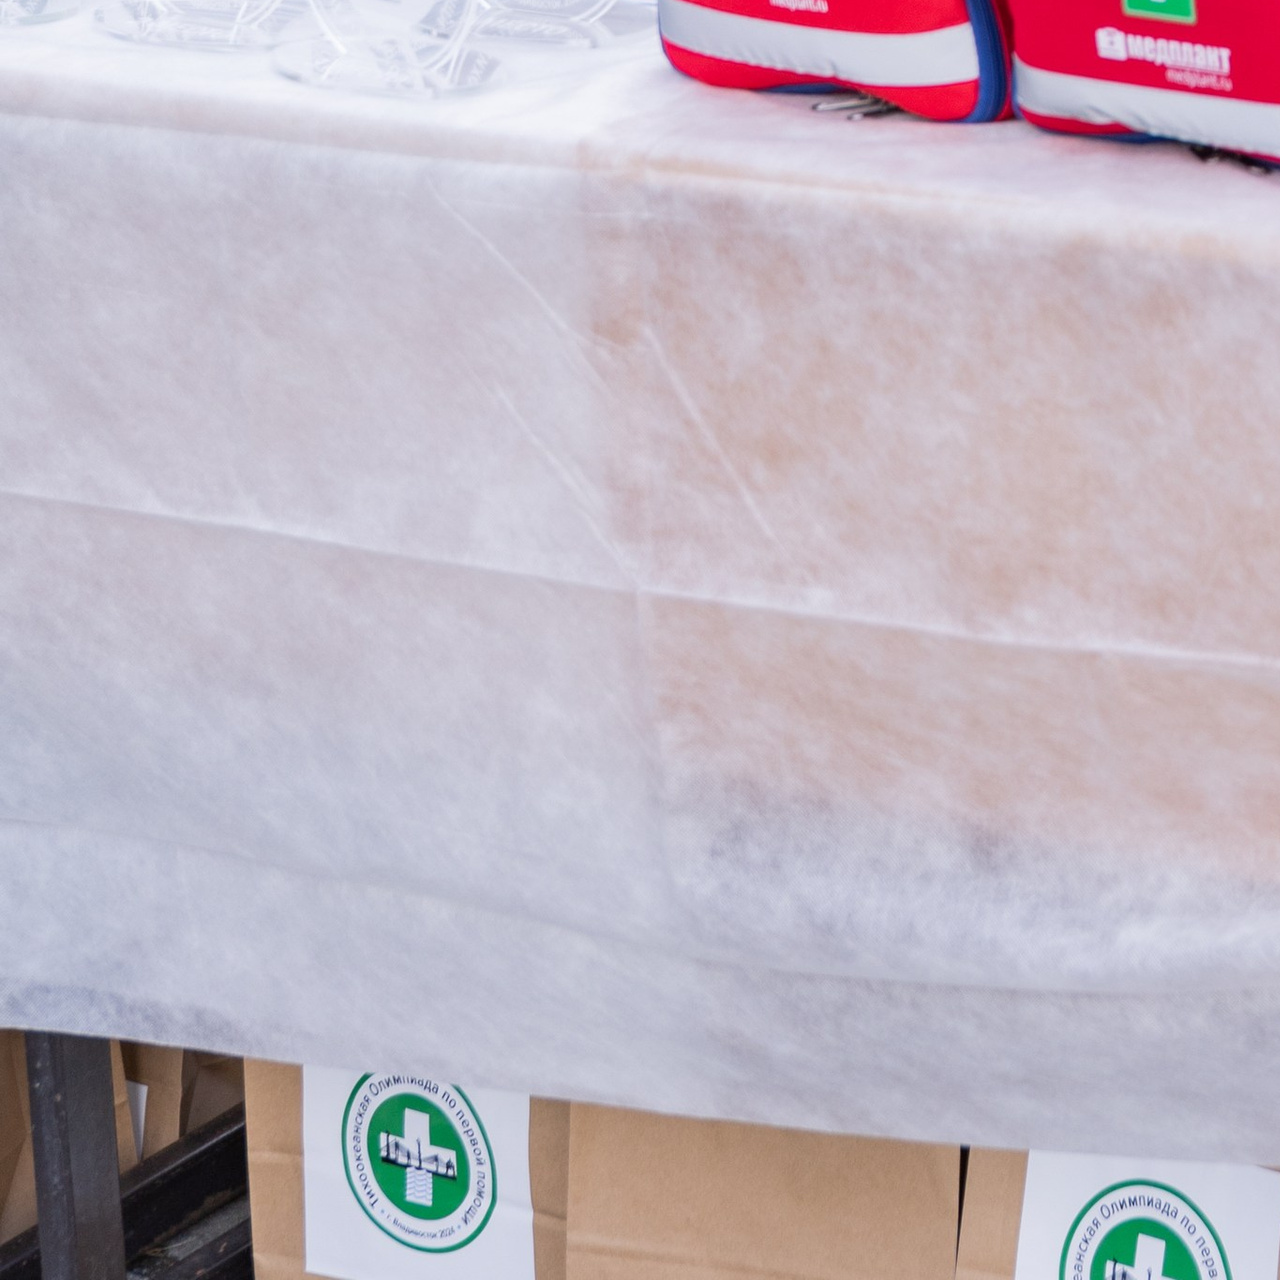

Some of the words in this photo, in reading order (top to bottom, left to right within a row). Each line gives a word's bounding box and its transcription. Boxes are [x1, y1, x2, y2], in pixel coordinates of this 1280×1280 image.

[441, 1090, 457, 1109] по
[352, 1093, 379, 1209] Тихоокеанская
[455, 1109, 485, 1166] первой
[461, 1170, 486, 1226] помощи
[1100, 1194, 1179, 1220] Олимпиада
[1180, 1214, 1197, 1236] по
[1195, 1235, 1219, 1280] перв
